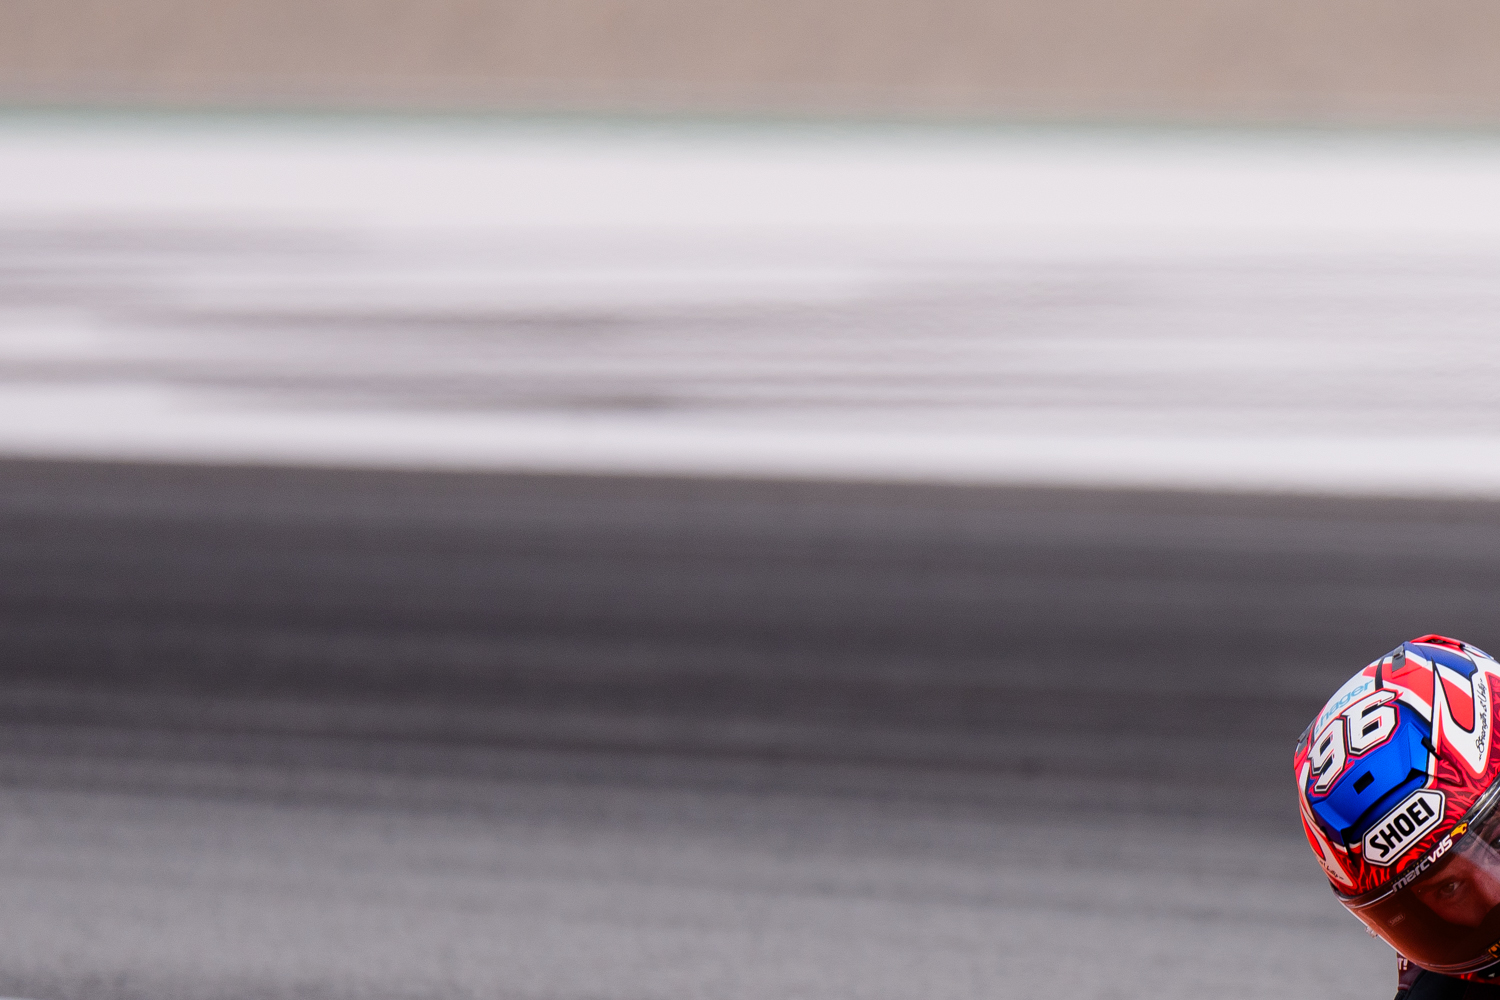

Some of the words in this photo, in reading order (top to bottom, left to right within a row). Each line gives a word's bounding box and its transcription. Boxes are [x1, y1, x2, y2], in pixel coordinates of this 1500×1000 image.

[1315, 680, 1374, 734] hager
[1308, 690, 1398, 793] 96
[1369, 797, 1435, 859] SHOEI
